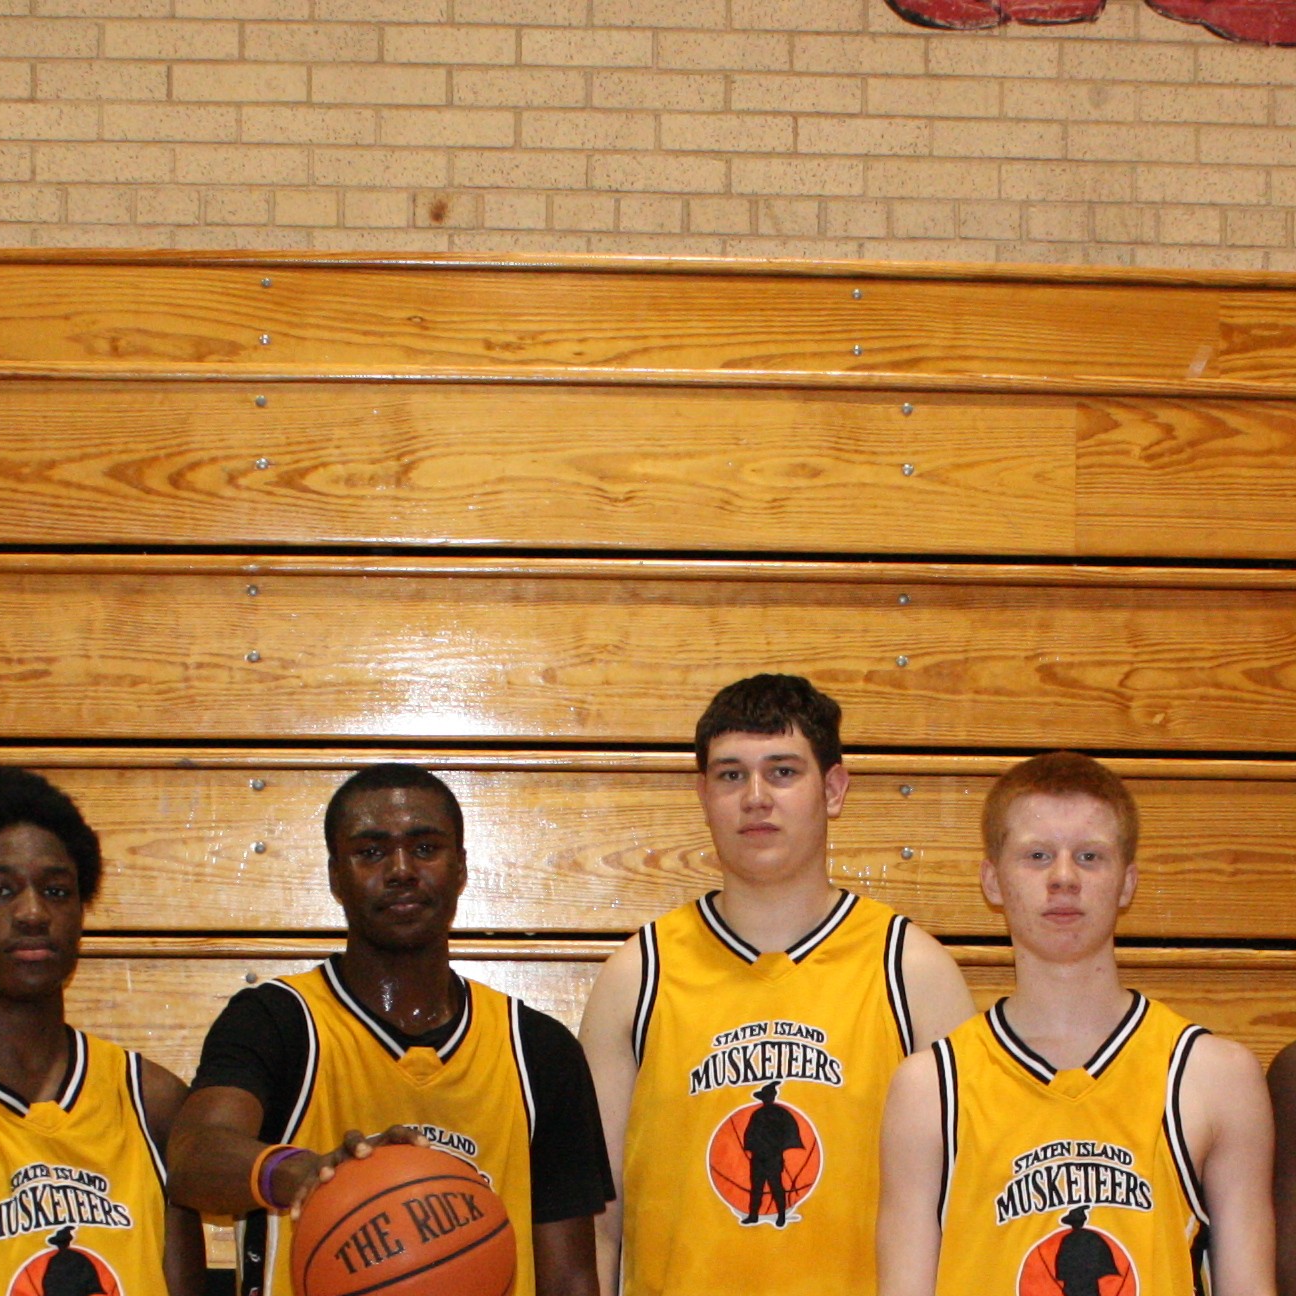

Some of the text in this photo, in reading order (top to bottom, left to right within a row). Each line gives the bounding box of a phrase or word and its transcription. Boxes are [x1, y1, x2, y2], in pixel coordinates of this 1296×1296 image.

[713, 1021, 825, 1046] STATEN ISLAND
[690, 1041, 842, 1094] MUSKETEERS
[1014, 1141, 1132, 1174] STATEN ISLAND
[53, 1167, 107, 1192] ISLAND
[996, 1162, 1152, 1223] MUSKETEERS
[334, 1192, 484, 1274] THE ROCK
